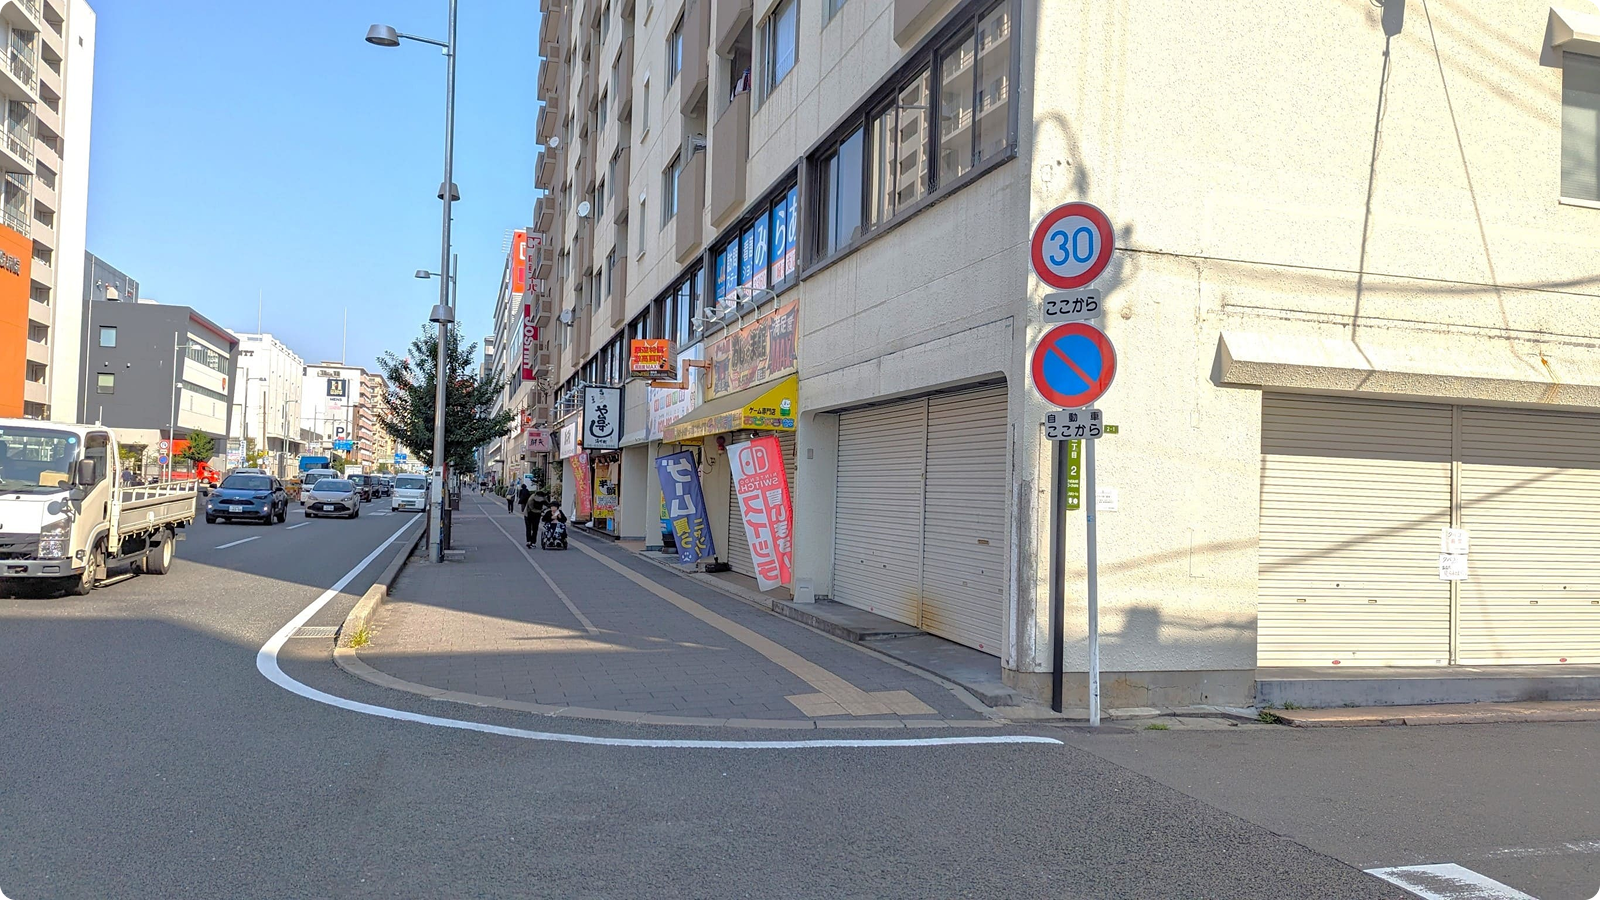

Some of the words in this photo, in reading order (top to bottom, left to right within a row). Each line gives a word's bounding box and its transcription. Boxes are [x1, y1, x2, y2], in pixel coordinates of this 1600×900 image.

[1049, 226, 1094, 267] 30
[1046, 296, 1098, 316] ここから
[748, 407, 776, 416] ゲーム専門店
[1047, 411, 1100, 424] 自動車
[336, 427, 345, 438] P
[1047, 423, 1101, 438] ここから
[1070, 465, 1077, 476] 2
